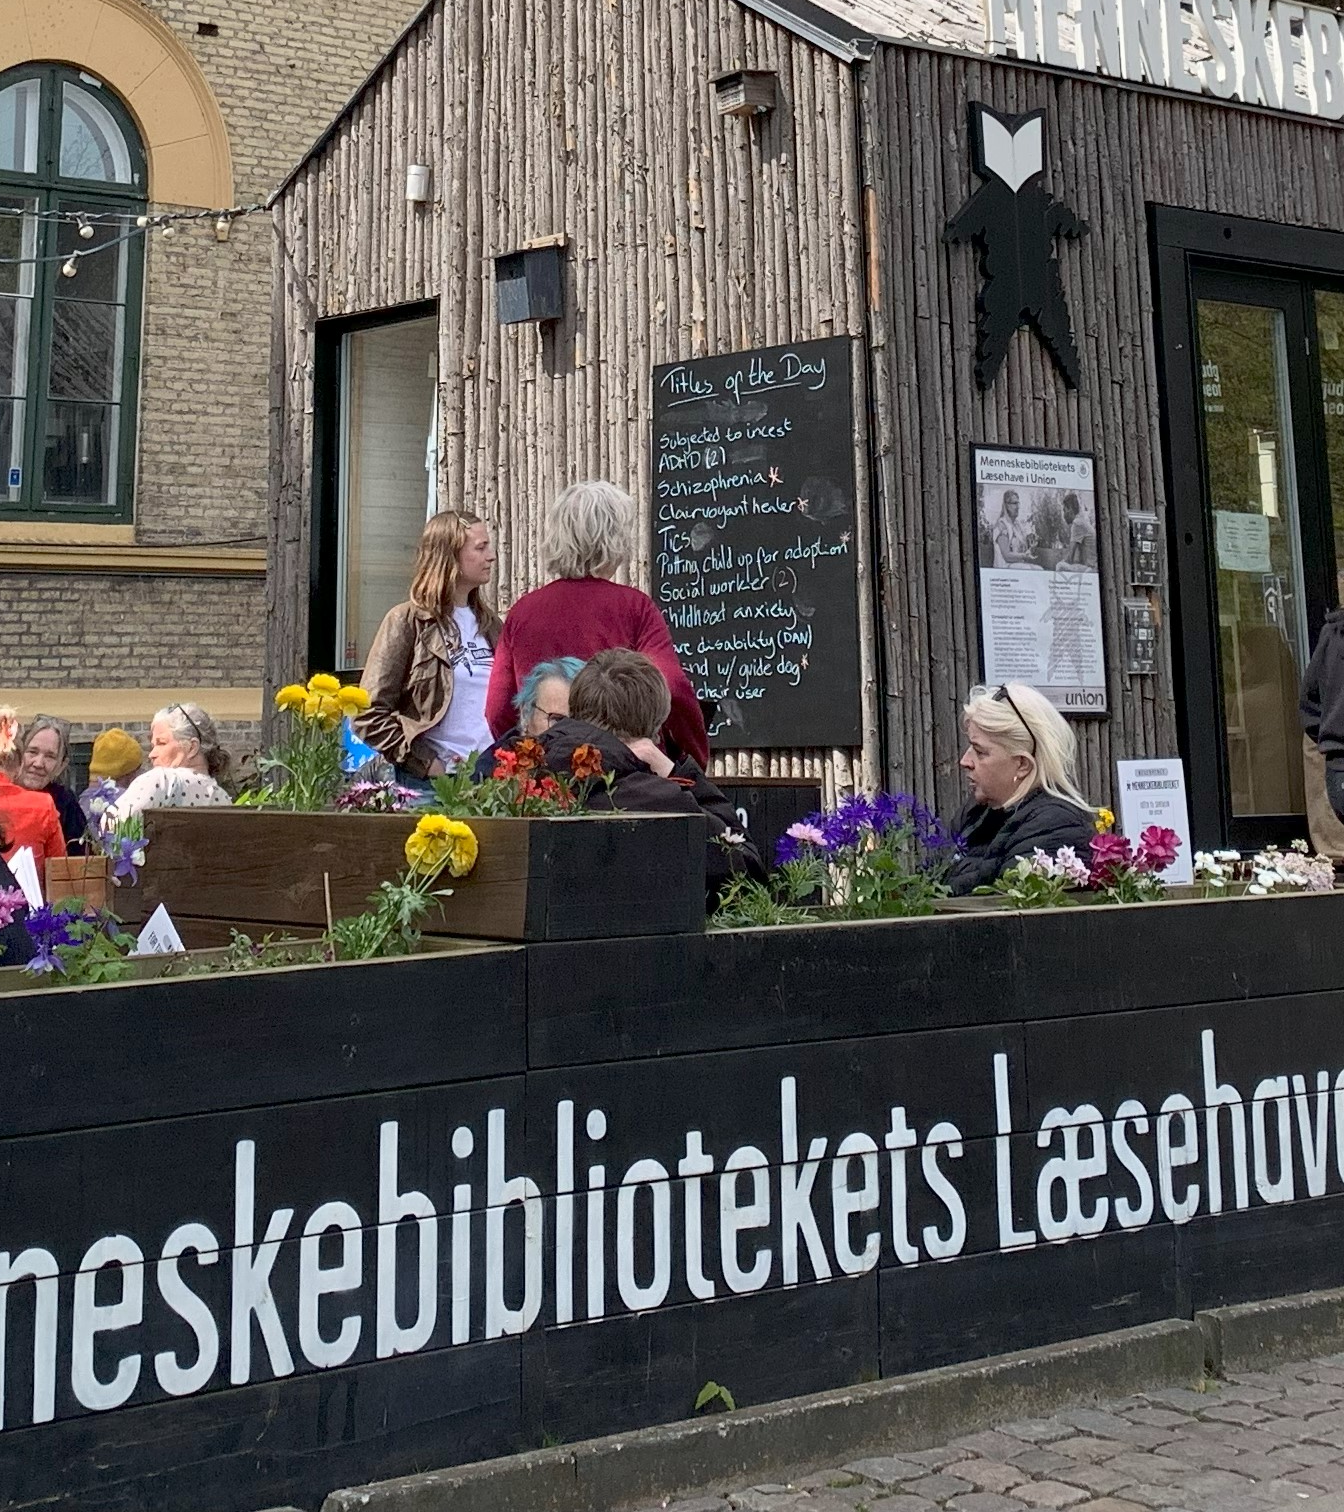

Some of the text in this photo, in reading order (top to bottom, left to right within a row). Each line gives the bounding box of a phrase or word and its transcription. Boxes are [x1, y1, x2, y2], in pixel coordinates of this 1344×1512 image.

[660, 353, 826, 405] Titles of the Day
[659, 418, 793, 454] Subjected to incest
[658, 446, 726, 474] ADHD (2)
[980, 455, 1076, 474] Menneskebibliotekets
[980, 469, 1025, 484] Læsehave
[1030, 474, 1057, 485] Union
[658, 494, 797, 530] Clairvoyant healer
[657, 524, 691, 553] Tics
[656, 535, 849, 585] Putting child up for adoption
[659, 565, 798, 603] Social worker (2)
[733, 599, 797, 630] anxiety
[697, 631, 776, 659] disability
[717, 655, 737, 686] w/
[738, 658, 773, 689] guide
[776, 654, 801, 686] dog
[735, 686, 766, 700] user
[1065, 689, 1105, 708] union
